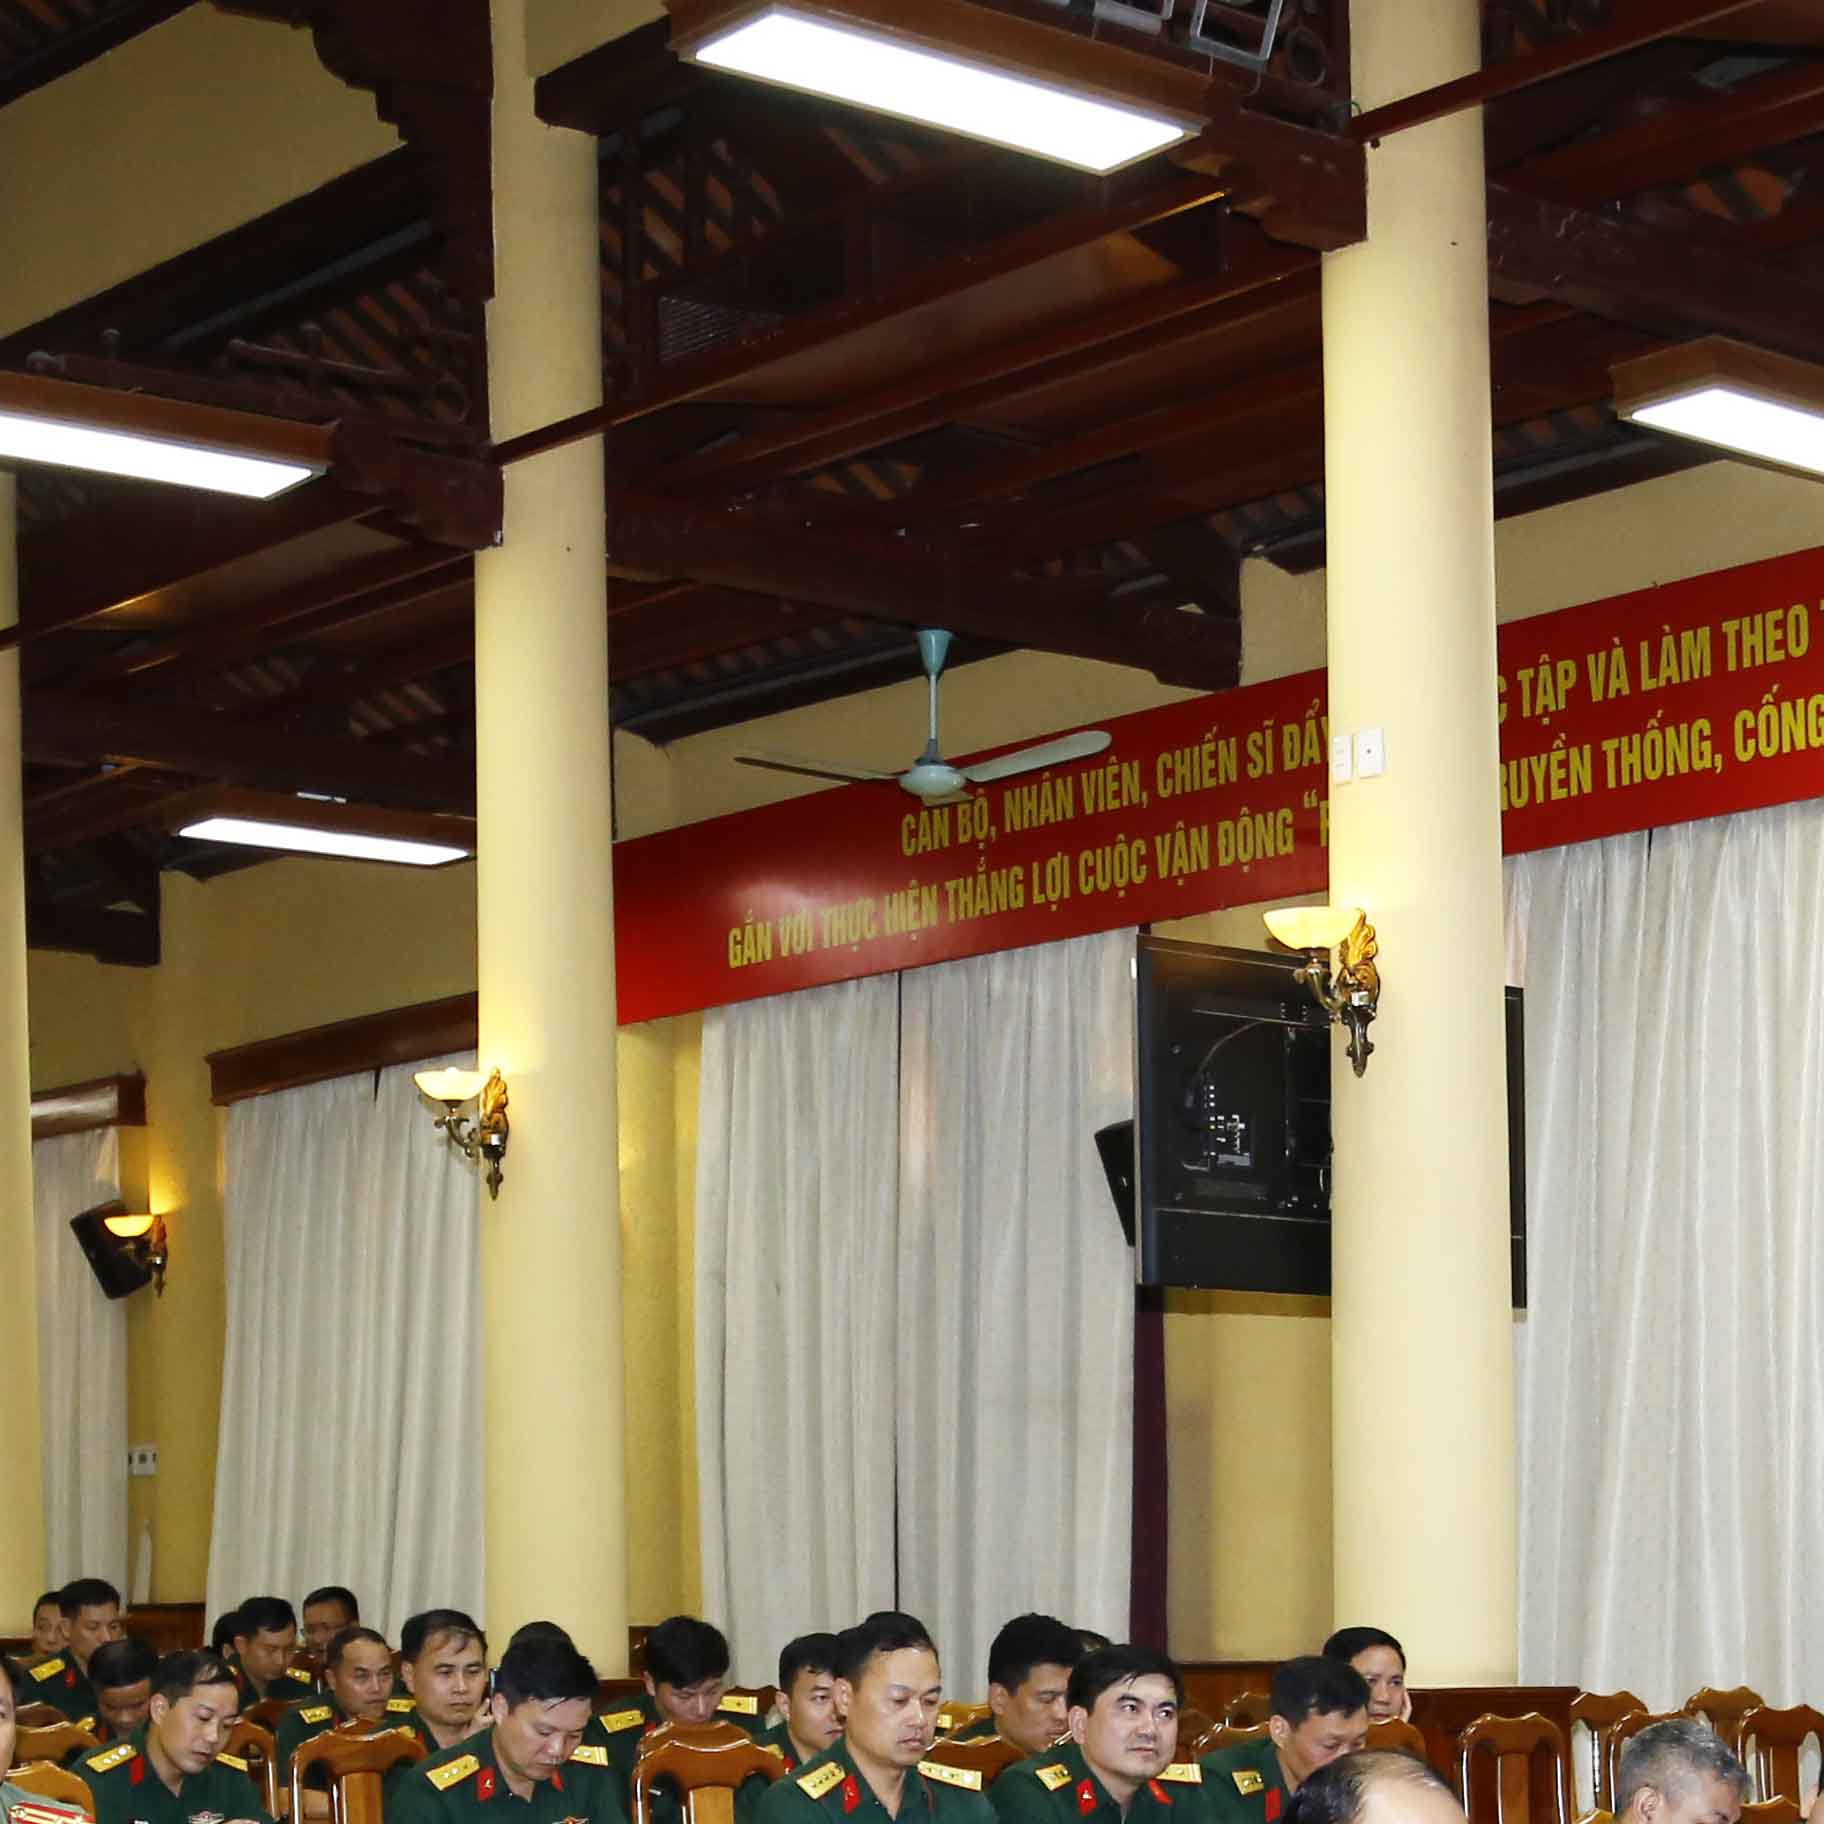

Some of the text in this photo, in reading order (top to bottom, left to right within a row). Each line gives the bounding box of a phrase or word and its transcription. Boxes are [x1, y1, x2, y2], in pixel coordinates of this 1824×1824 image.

[1517, 653, 1577, 725] TẬP
[1587, 636, 1630, 703] VÀ
[1639, 624, 1712, 692] LÀM
[1722, 603, 1810, 672] THEO
[957, 787, 997, 849] BỘ,
[1004, 771, 1074, 834] NHÂN
[1081, 755, 1148, 816] VIÊN,
[1156, 725, 1237, 799] CHIẾN
[1246, 719, 1275, 780] SĨ
[1601, 709, 1724, 791] THỐNG,
[728, 907, 773, 969] GẮN
[821, 896, 877, 952] THỰC
[884, 880, 939, 941] HIỆN
[945, 857, 1024, 924] THẮNG
[1032, 851, 1071, 912] LỢI
[1079, 834, 1148, 898] CUỘC
[1155, 820, 1210, 887] VẬN
[1217, 807, 1295, 873] ĐỘNG
